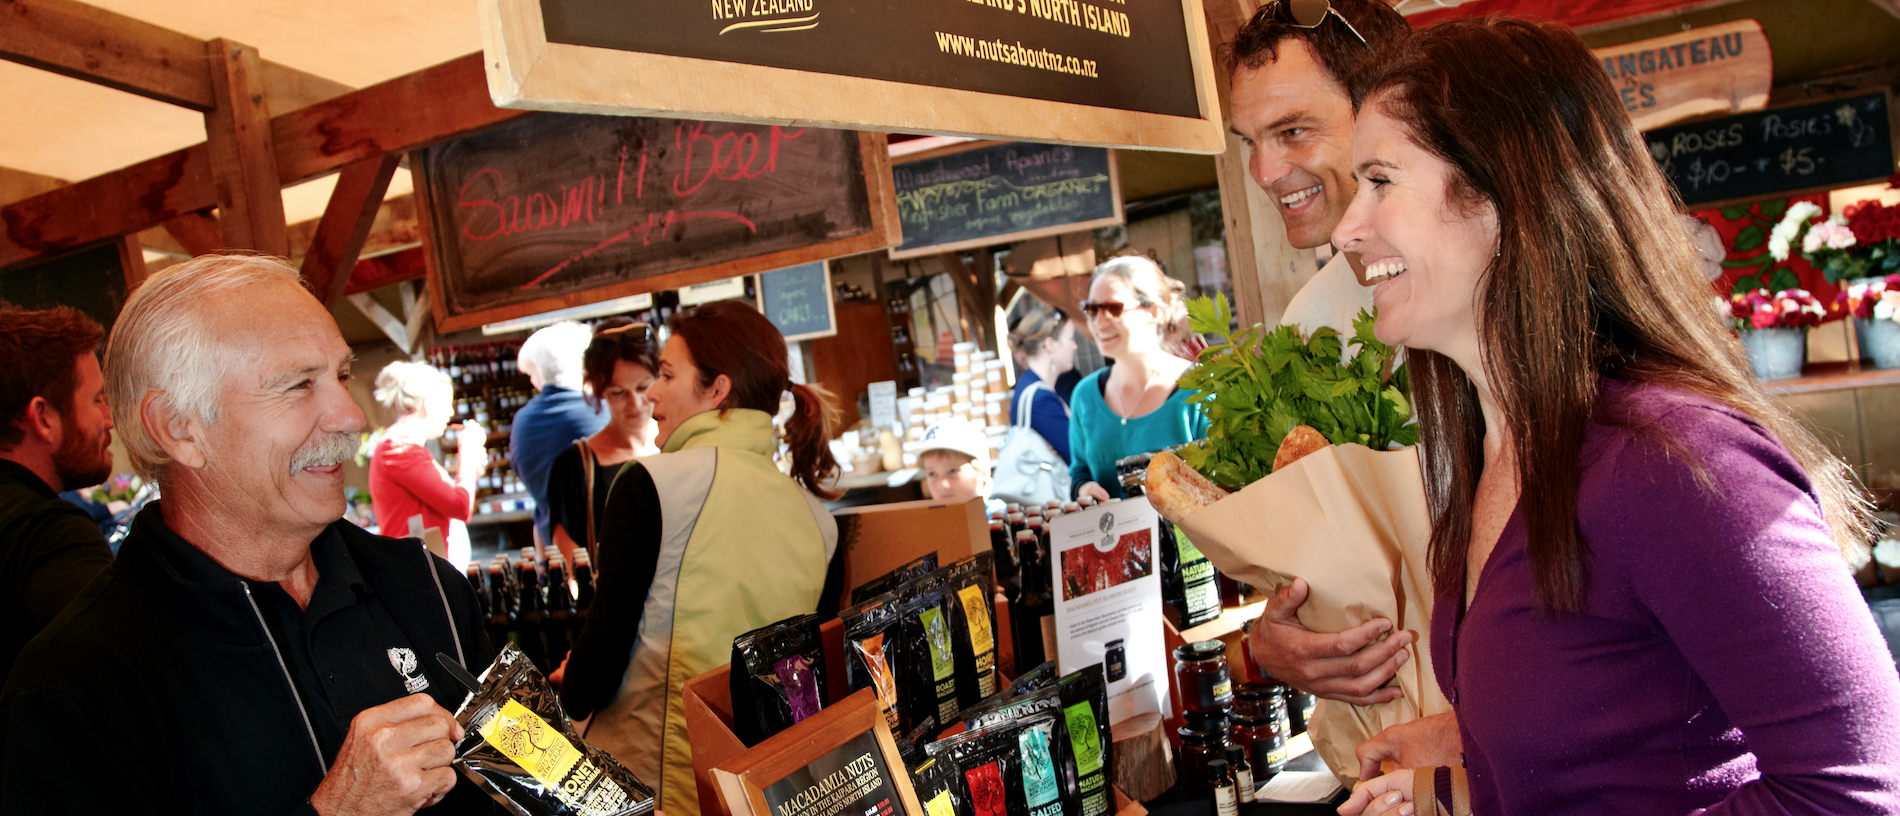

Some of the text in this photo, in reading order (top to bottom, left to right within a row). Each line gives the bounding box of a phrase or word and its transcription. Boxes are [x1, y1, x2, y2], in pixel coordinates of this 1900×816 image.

[712, 0, 746, 19] NEW
[1030, 0, 1081, 27] NORTH
[1083, 3, 1130, 38] ISLAND
[935, 31, 1098, 78] www.nutsaboutnz.co.nz
[1672, 123, 1743, 157] ROSES
[536, 738, 562, 773] NUTS ABOUT
[540, 740, 568, 777] NEW ZEALAND
[554, 756, 596, 804] HONEY
[778, 752, 875, 816] MACADAMIA NUTS
[808, 803, 819, 816] IN
[818, 793, 832, 810] THE
[832, 782, 857, 801] KAIPARA
[855, 767, 880, 787] REGION
[843, 790, 864, 807] NORTH
[862, 776, 883, 796] ISLAND
[1030, 802, 1062, 816] SALTED
